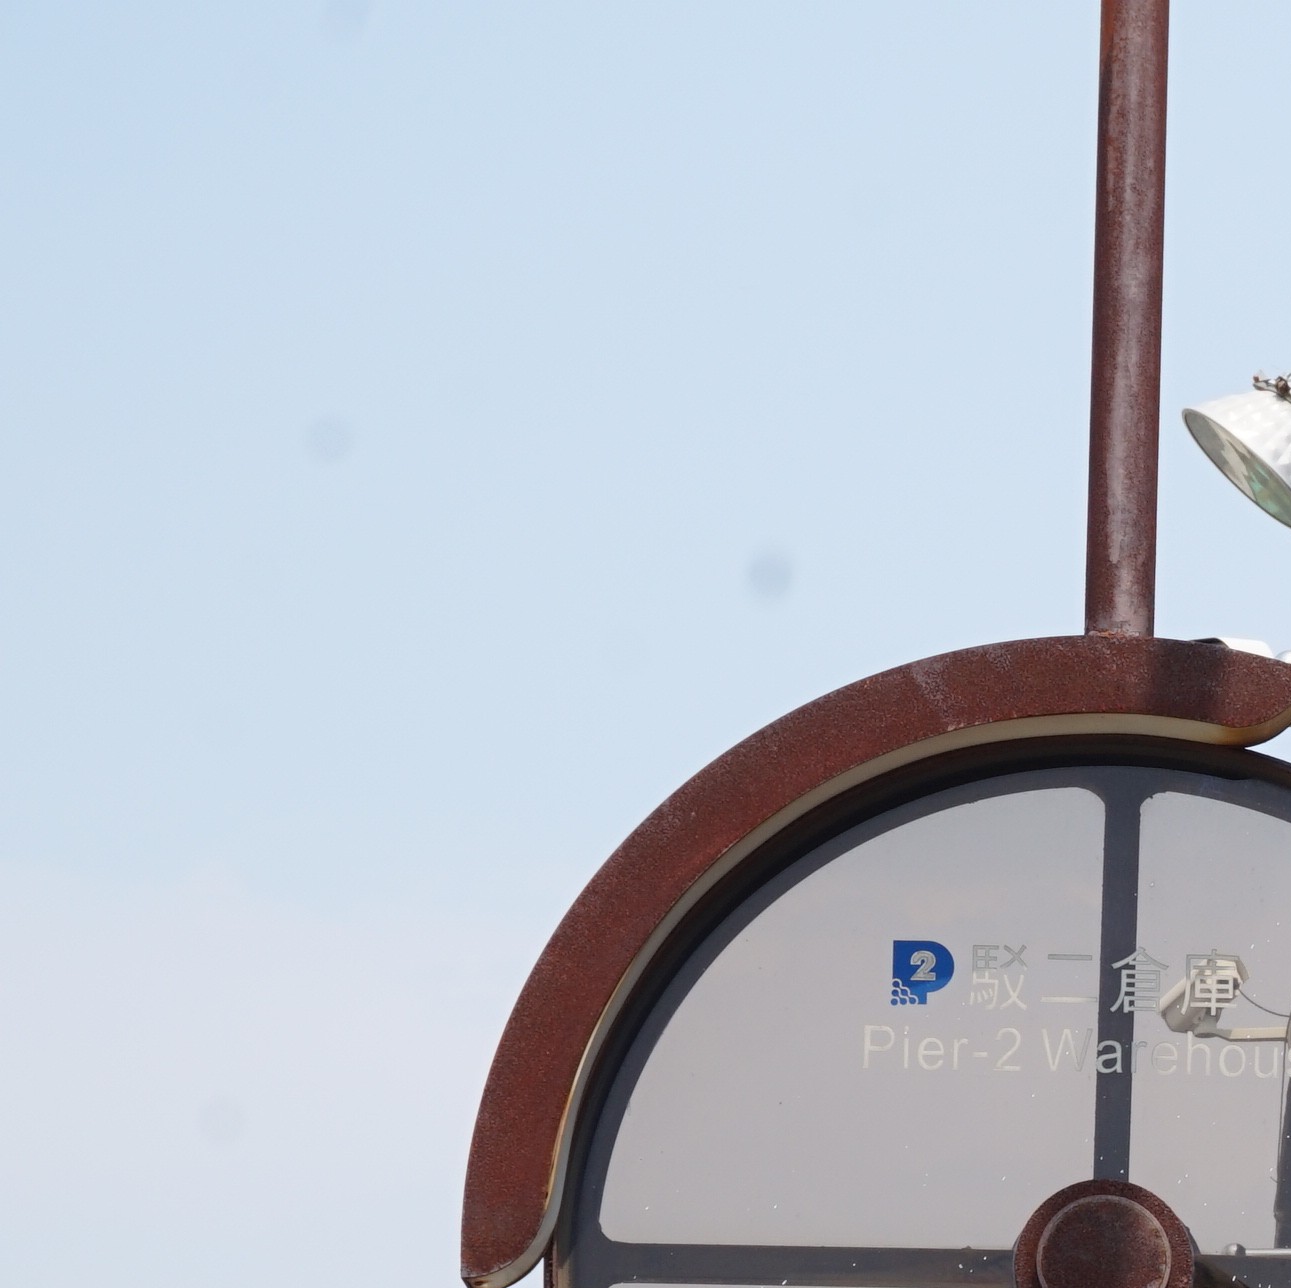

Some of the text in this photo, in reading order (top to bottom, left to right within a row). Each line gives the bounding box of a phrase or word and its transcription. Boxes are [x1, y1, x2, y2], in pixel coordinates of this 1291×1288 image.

[969, 942, 1242, 1017] 駁二倉庫
[861, 1023, 1022, 1072] Pier-2
